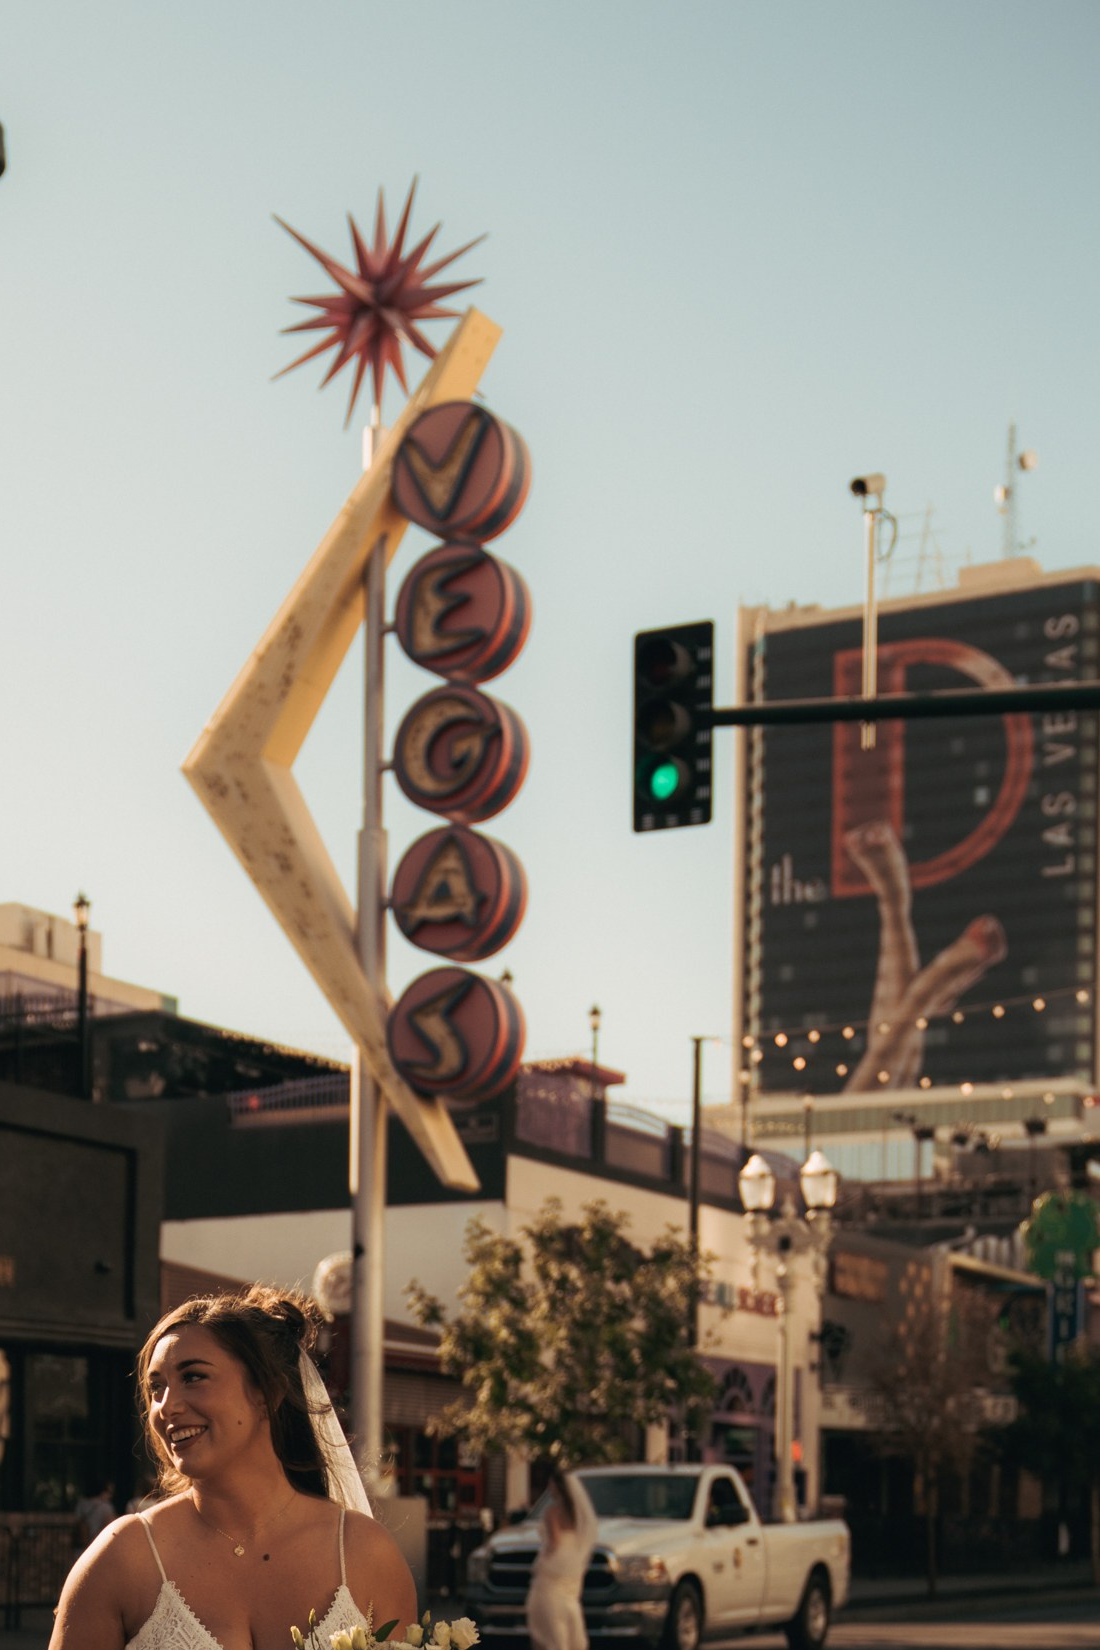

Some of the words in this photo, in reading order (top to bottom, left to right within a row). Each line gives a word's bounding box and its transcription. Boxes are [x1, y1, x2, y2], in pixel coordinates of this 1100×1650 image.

[398, 403, 502, 1081] VEGAS
[770, 851, 826, 905] the
[831, 637, 1034, 897] D
[1042, 612, 1079, 768] VEAS
[1041, 790, 1076, 877] LAS
